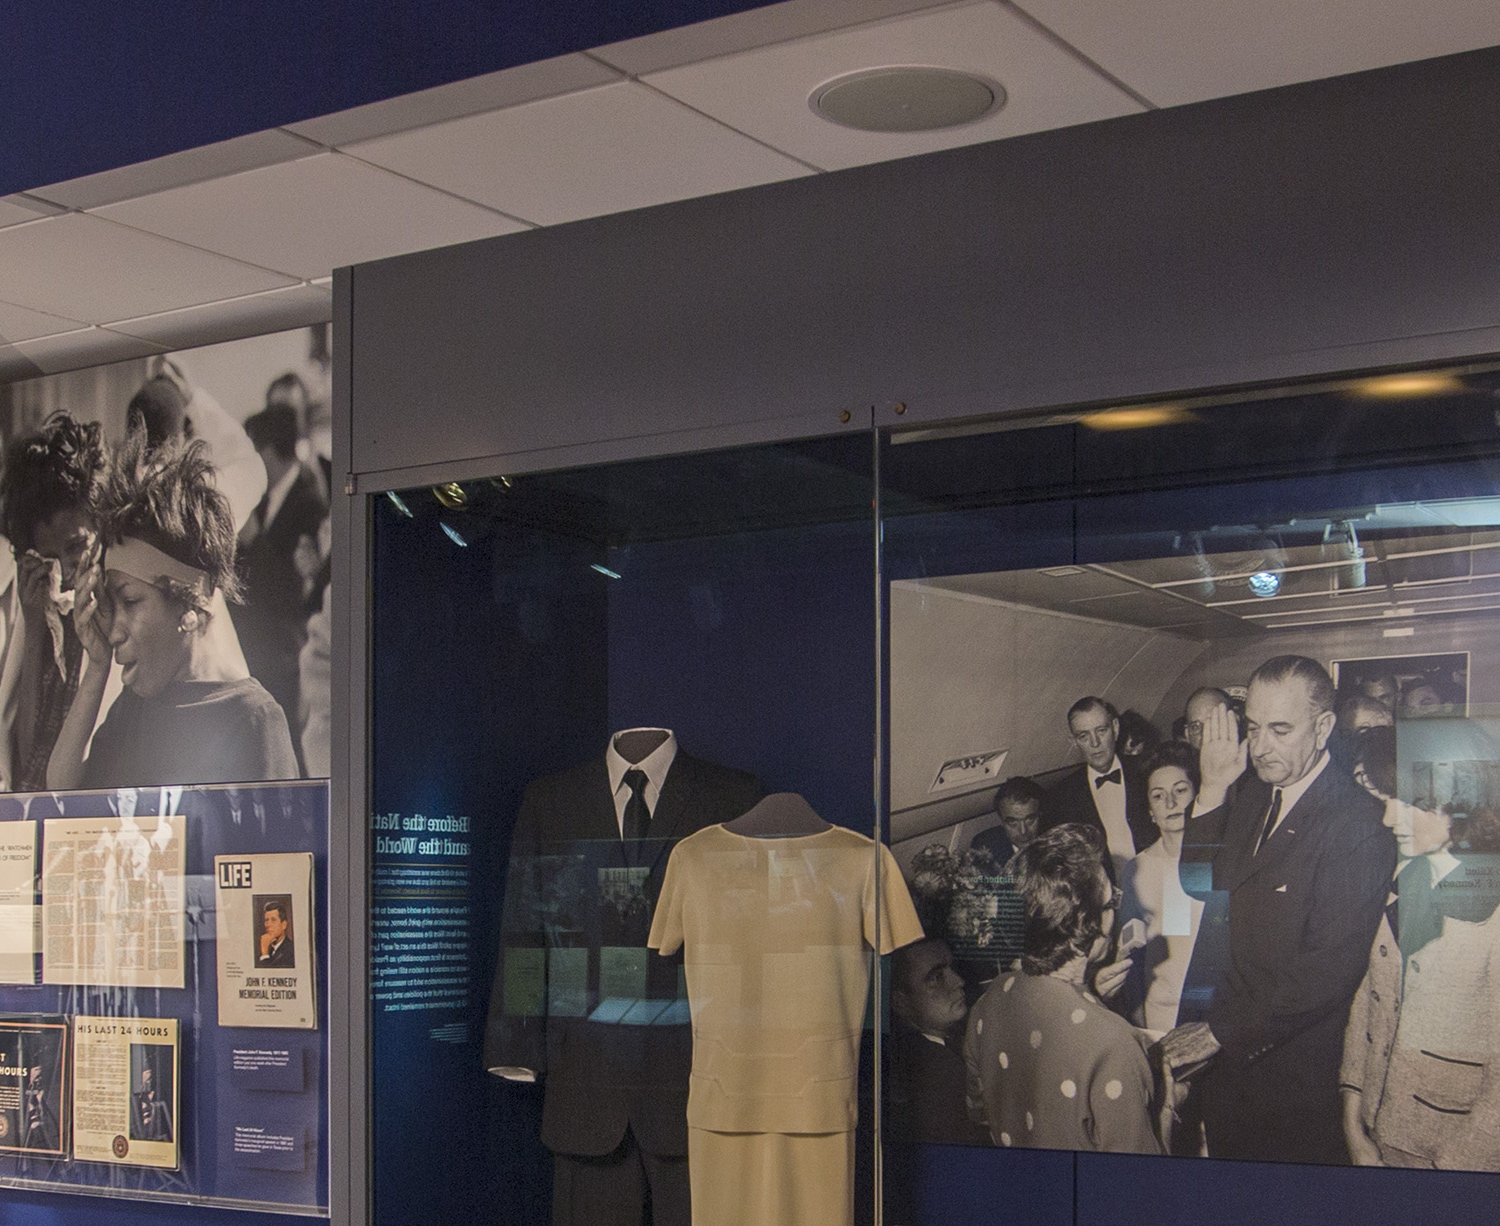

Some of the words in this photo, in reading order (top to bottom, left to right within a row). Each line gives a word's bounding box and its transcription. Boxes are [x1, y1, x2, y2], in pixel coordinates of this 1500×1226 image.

[220, 864, 251, 887] LIFE
[246, 978, 260, 987] JOHN
[262, 978, 266, 987] F.
[268, 977, 297, 987] KENNEDY
[239, 990, 269, 999] MEMORIAL
[271, 990, 297, 999] EDITION
[77, 1025, 92, 1033] HIS
[95, 1025, 117, 1034] LAST
[120, 1026, 132, 1034] 24
[136, 1026, 169, 1036] HOURS
